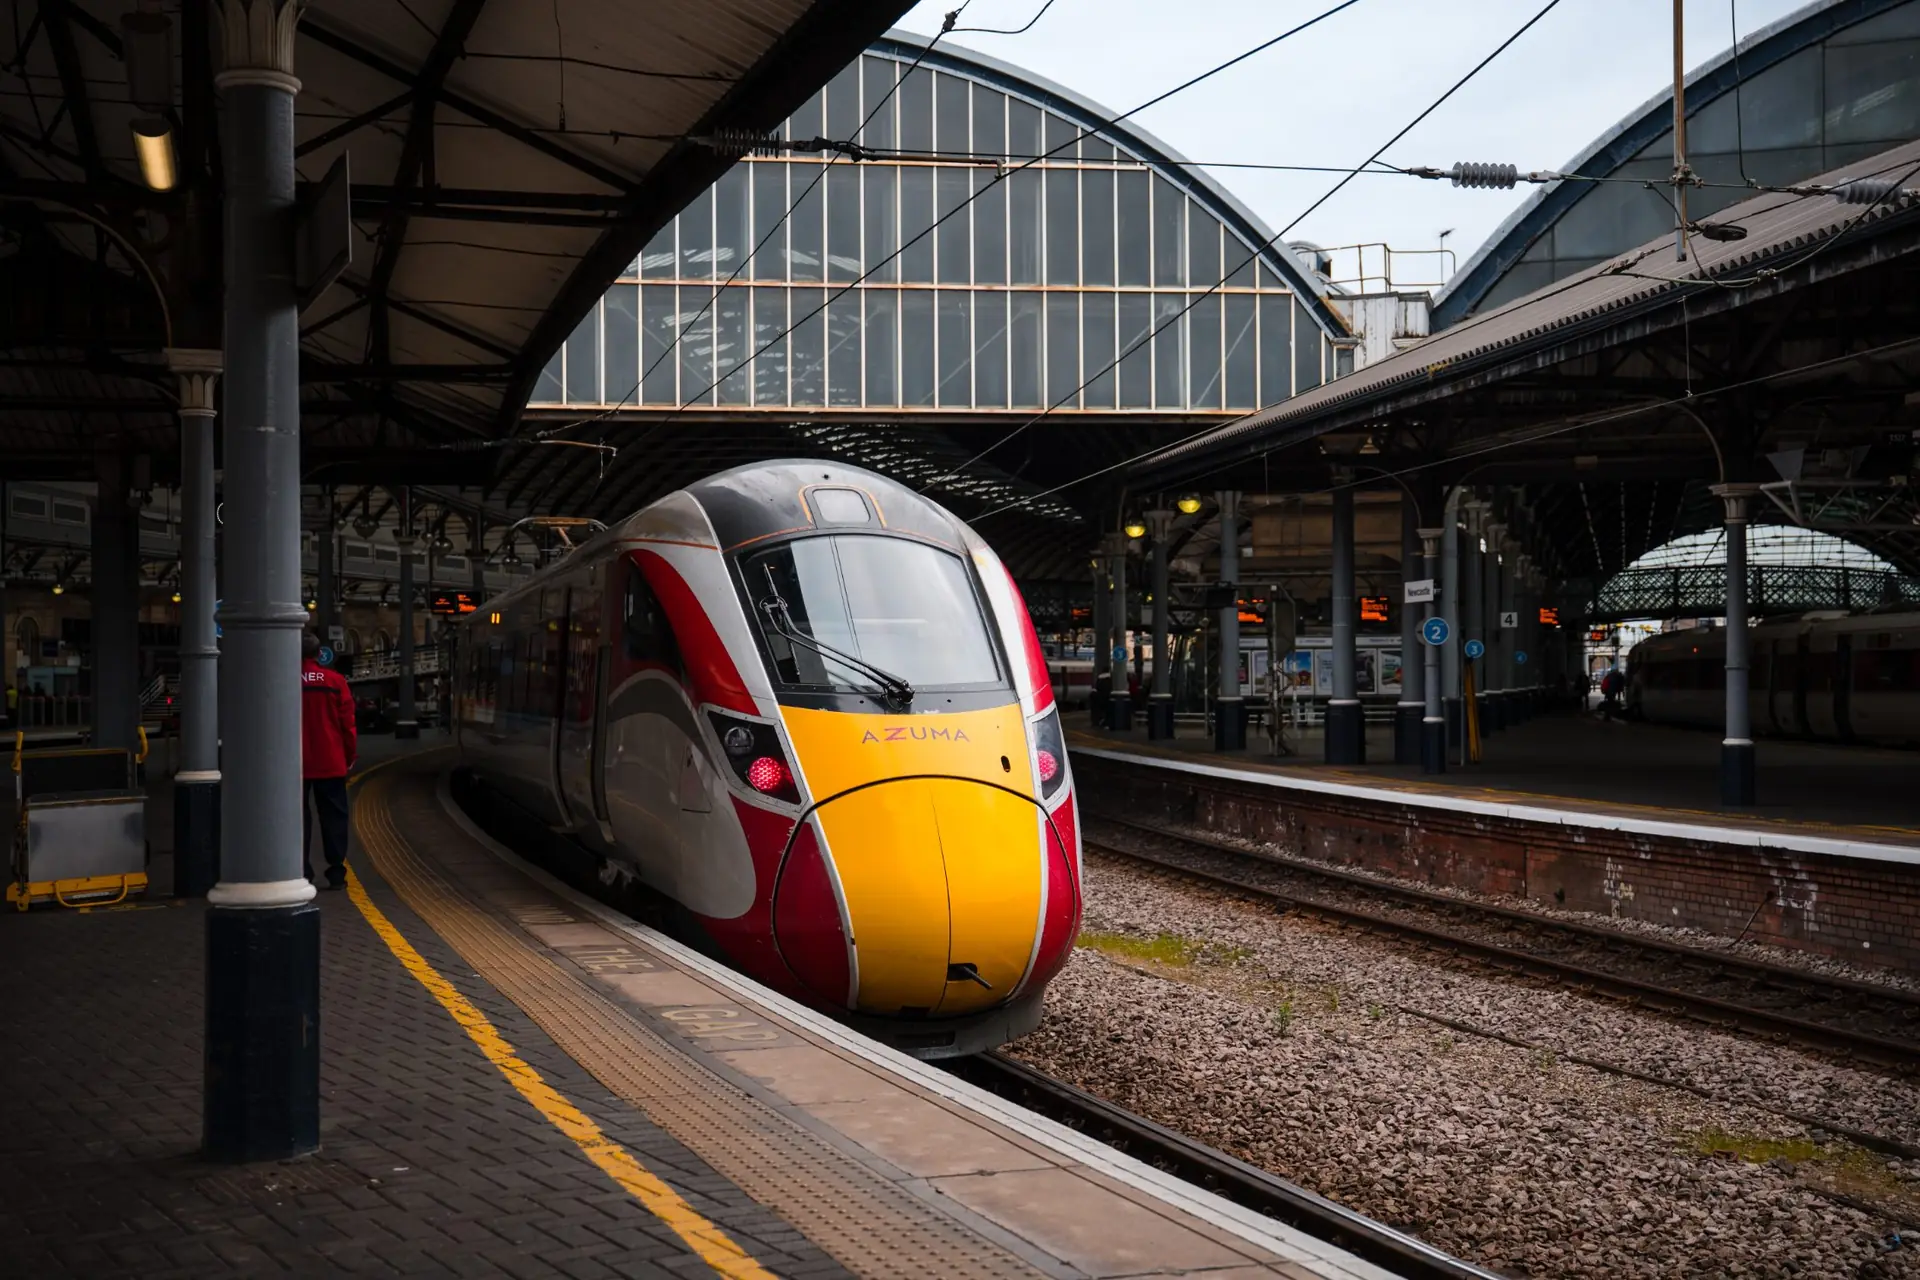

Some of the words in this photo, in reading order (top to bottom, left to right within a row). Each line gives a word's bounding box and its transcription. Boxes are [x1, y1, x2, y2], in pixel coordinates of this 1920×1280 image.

[1407, 586, 1430, 597] Newcastle
[1504, 614, 1514, 626] 4
[1085, 633, 1093, 644] 3
[1431, 626, 1441, 640] 2
[1471, 645, 1478, 655] 3
[320, 652, 328, 662] 3
[300, 671, 325, 682] NER
[861, 726, 970, 744] AZUMA
[569, 948, 654, 971] THE
[660, 1009, 780, 1041] GAP
